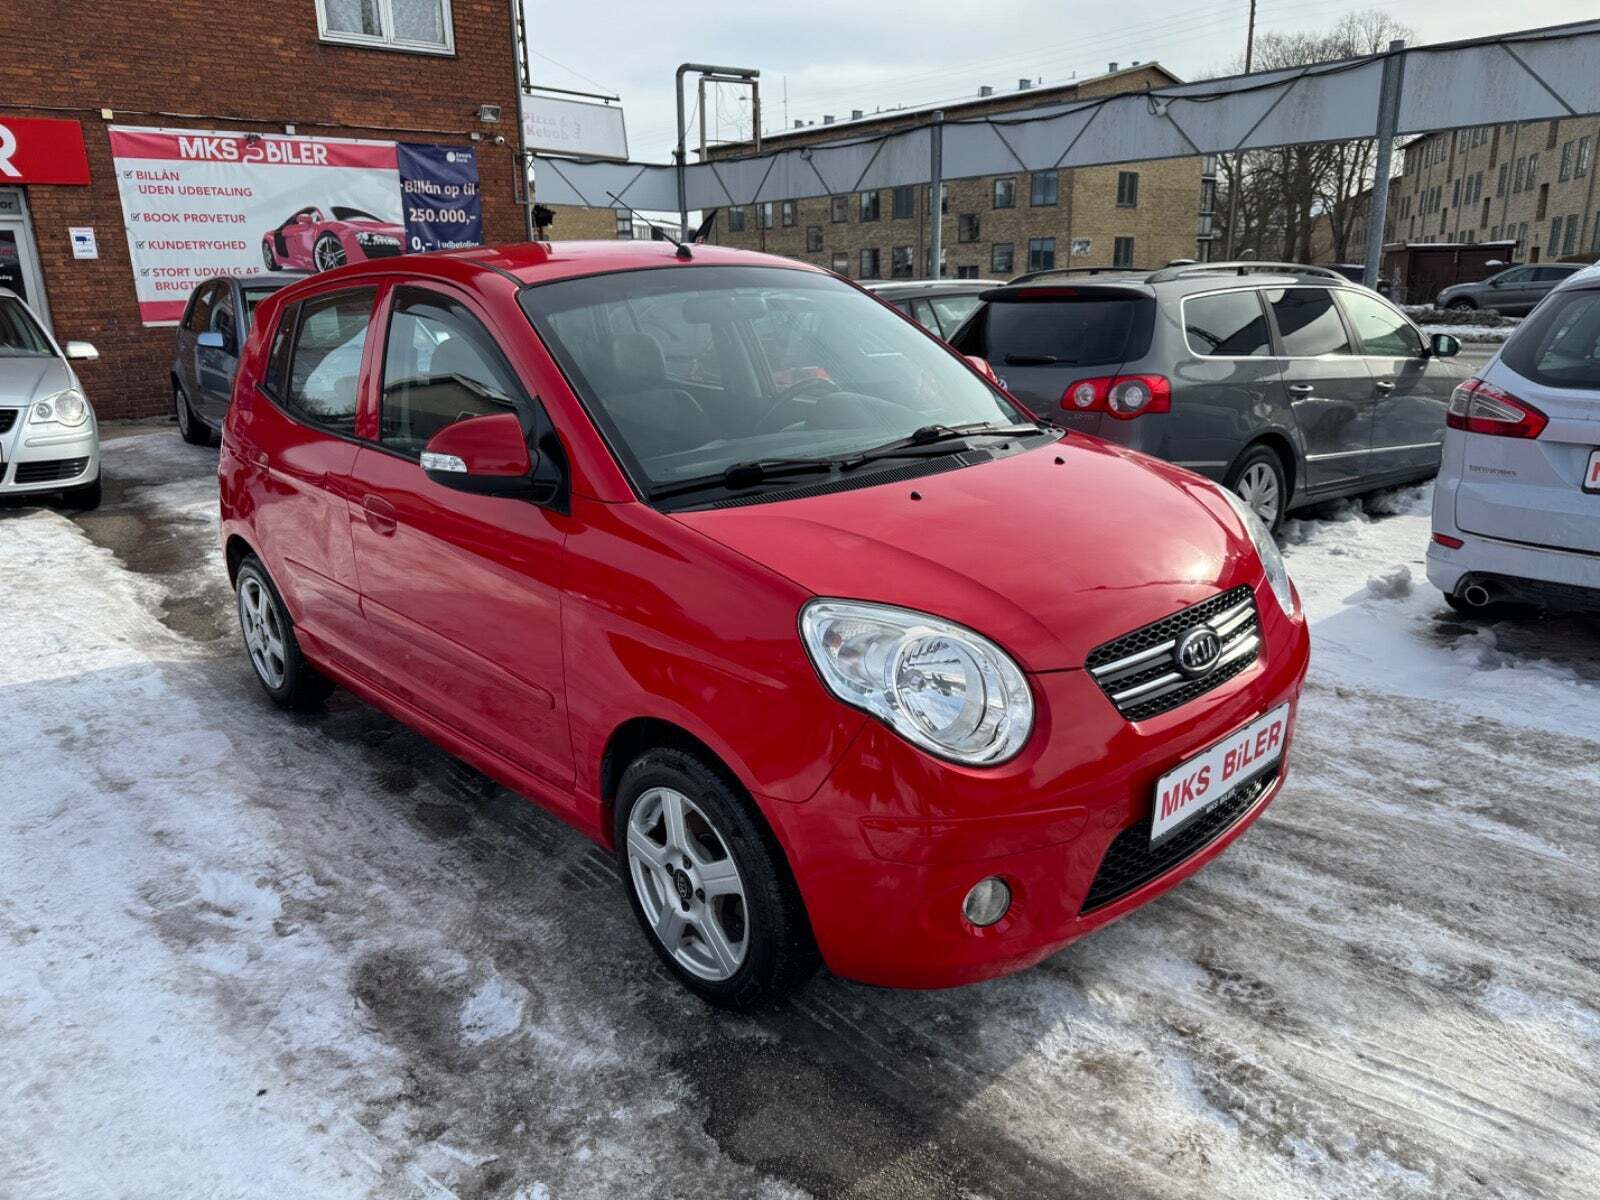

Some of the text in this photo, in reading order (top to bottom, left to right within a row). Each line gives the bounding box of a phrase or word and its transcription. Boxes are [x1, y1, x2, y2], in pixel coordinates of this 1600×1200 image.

[178, 137, 328, 165] MKS BILER
[136, 168, 180, 181] BILLÅN
[139, 185, 253, 197] UDEN UDBETALING
[404, 180, 475, 198] Billån op til
[143, 212, 247, 223] BOOK PRØVETUR
[409, 207, 476, 224] 250.000,-
[148, 240, 247, 250] KUNDETRYGHED
[411, 236, 432, 252] 0,-
[152, 267, 190, 277] STORT
[194, 267, 241, 277] UDVALG
[1187, 635, 1218, 666] KIA
[1160, 765, 1211, 821] MKS
